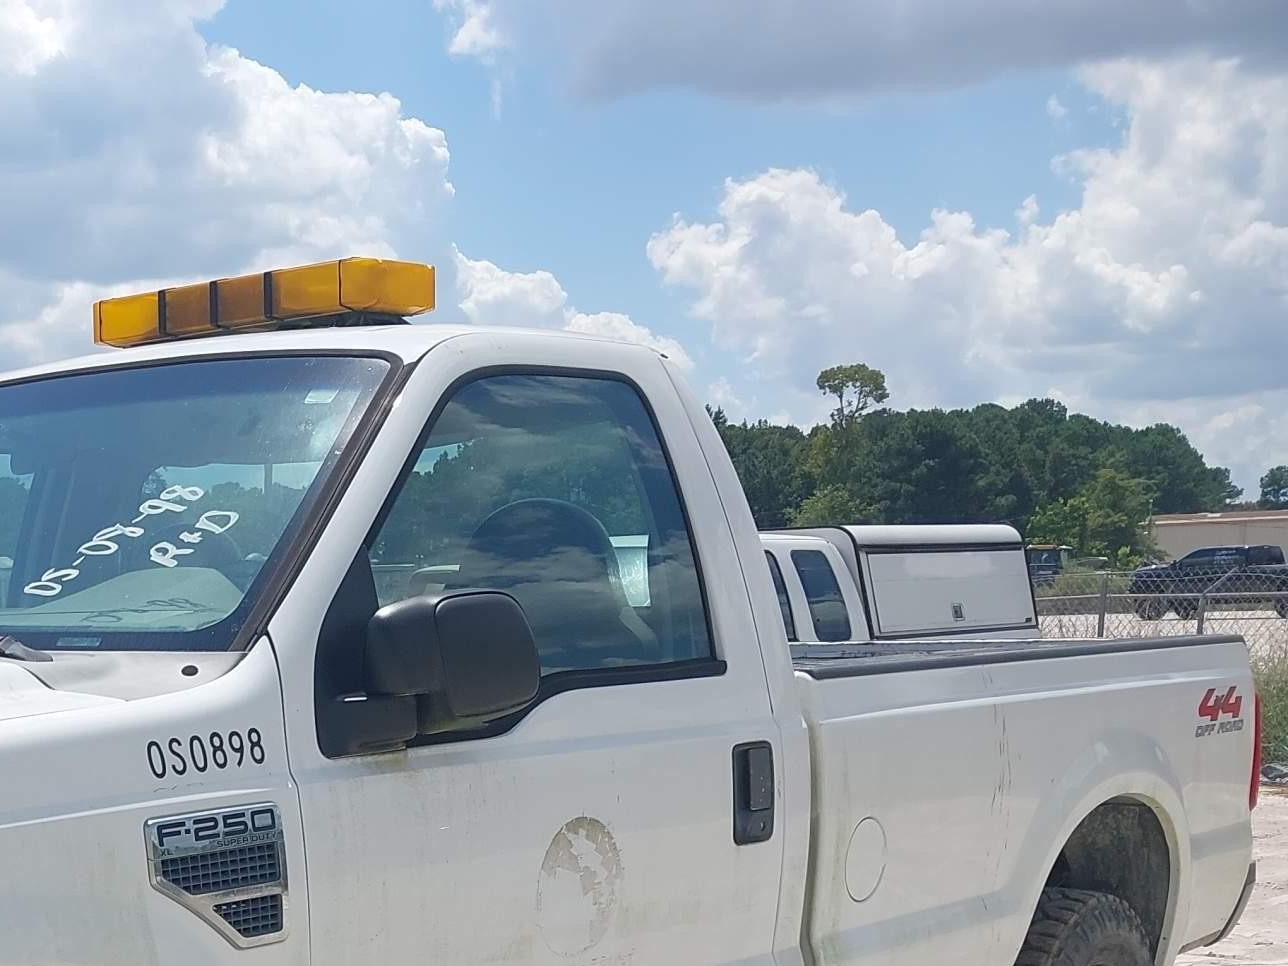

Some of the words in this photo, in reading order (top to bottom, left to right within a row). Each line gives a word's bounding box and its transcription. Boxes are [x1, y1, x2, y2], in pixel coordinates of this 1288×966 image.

[1195, 723, 1217, 738] OFF
[1217, 719, 1245, 734] ROAD
[216, 837, 249, 848] SUPER
[251, 831, 278, 843] DUTY
